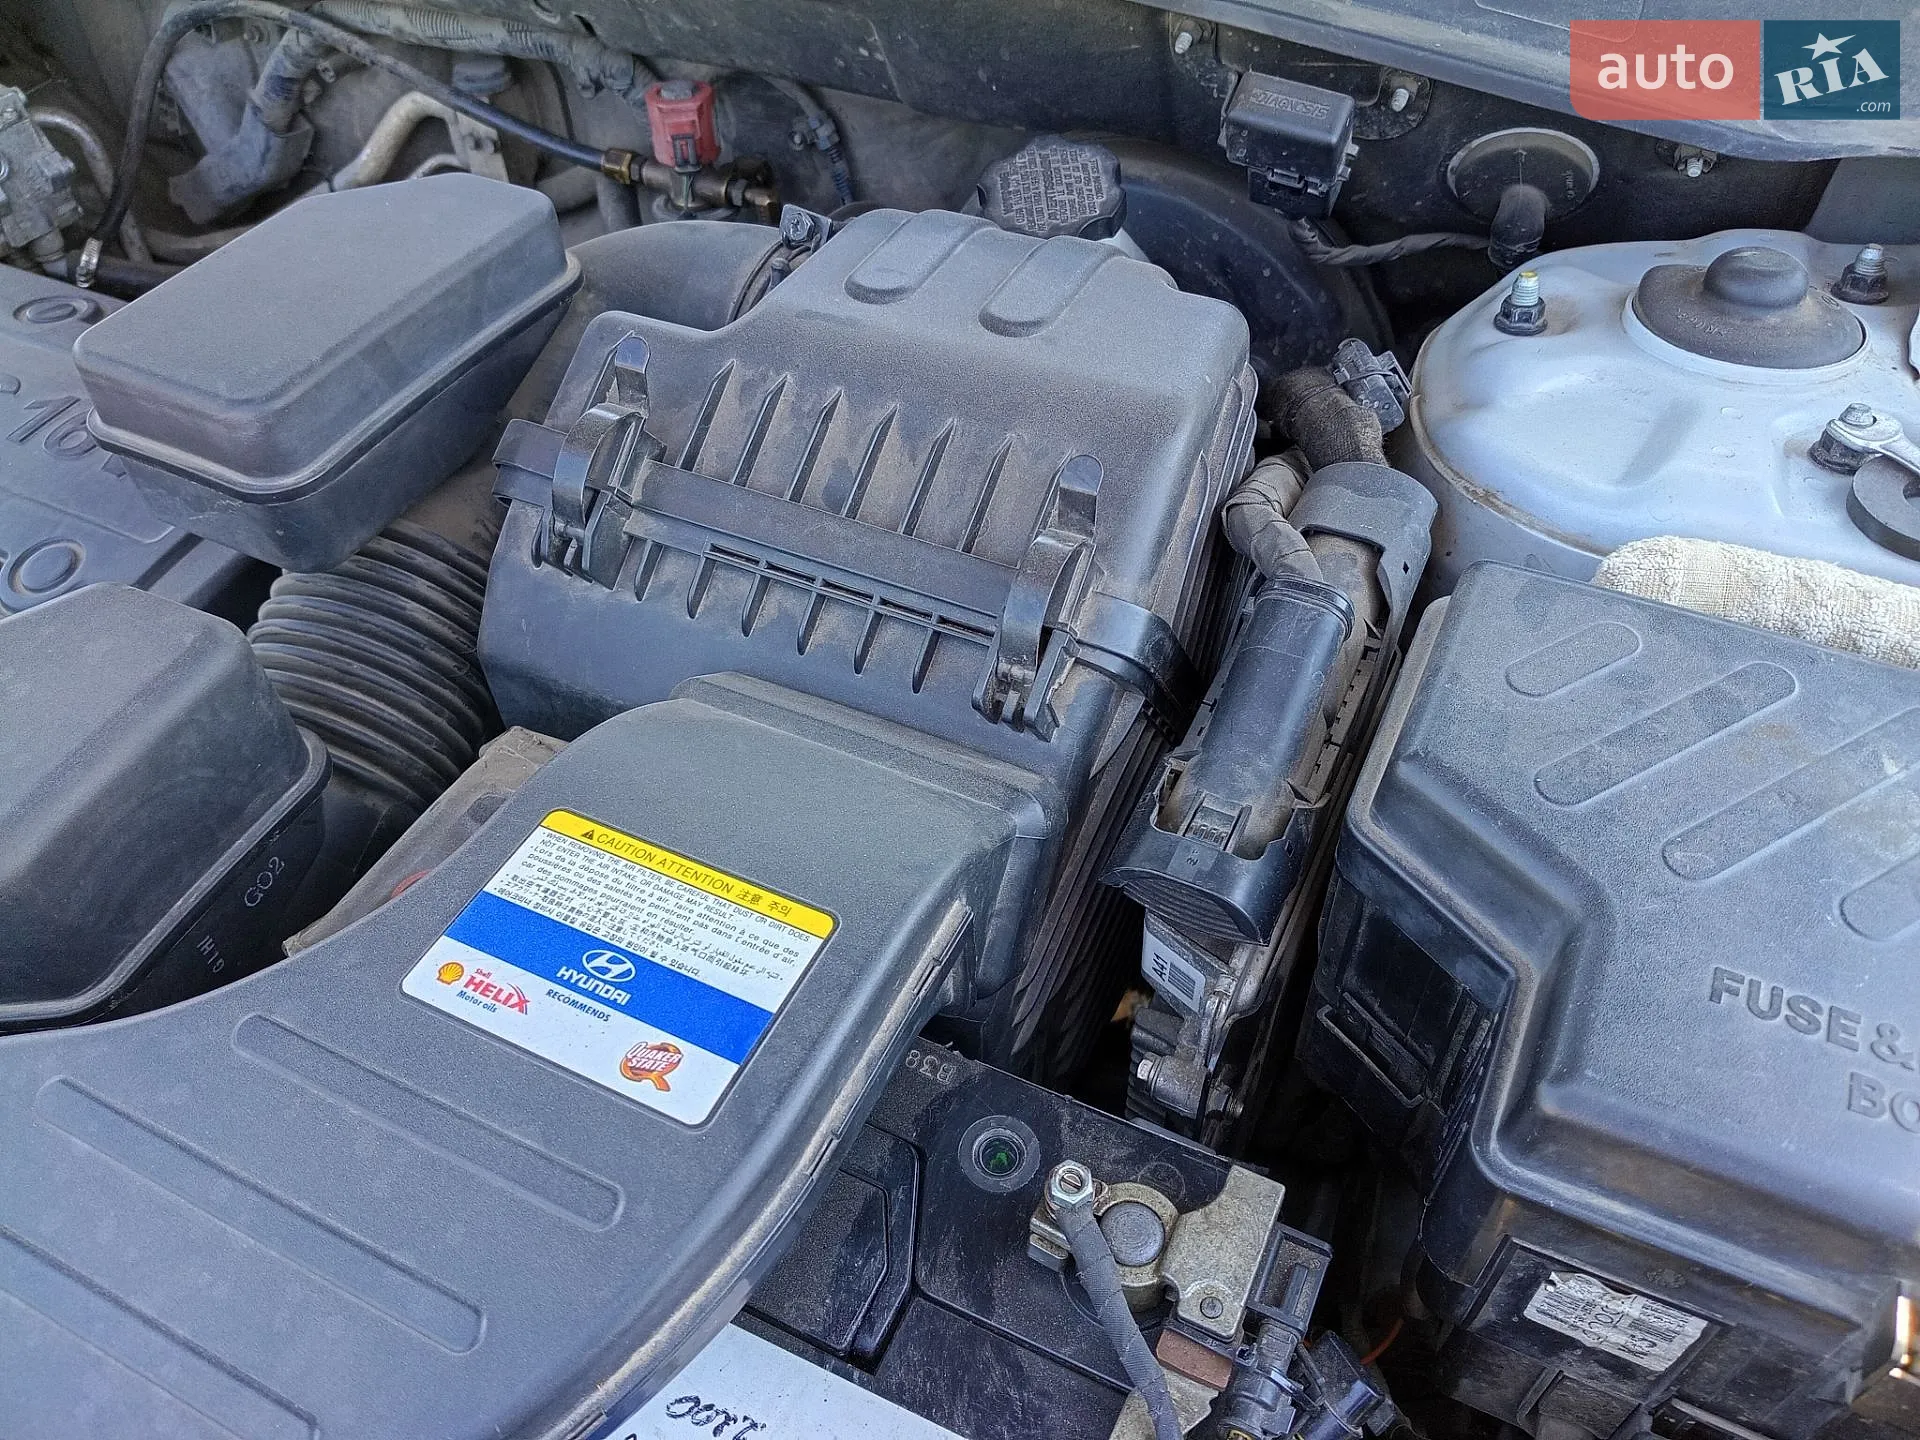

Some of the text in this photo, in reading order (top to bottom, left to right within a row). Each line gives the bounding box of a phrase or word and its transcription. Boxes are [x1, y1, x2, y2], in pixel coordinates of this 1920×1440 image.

[539, 838, 556, 848] NOT
[556, 844, 581, 858] ENTER
[580, 854, 597, 864] THE
[596, 860, 611, 870] AIR
[651, 883, 684, 900] DAMAGE
[684, 896, 703, 908] MAY
[545, 831, 568, 844] WHEN
[567, 840, 606, 859] REMOVING
[606, 855, 622, 865] THE
[621, 862, 636, 871] AIR
[663, 879, 676, 887] BE
[711, 898, 732, 910] THAT
[732, 906, 754, 919] DUST
[594, 832, 734, 894] CAUTION ATTENTION
[533, 845, 554, 857] Lors
[695, 911, 737, 932] attention
[761, 938, 781, 949] que
[552, 872, 599, 895] dommages
[765, 899, 793, 917] 주의
[710, 926, 734, 939] dans
[1151, 952, 1168, 982] A41
[455, 989, 500, 1013] Motor oils
[462, 975, 531, 1013] HELIX
[554, 965, 632, 1006] HYUNDAI
[544, 988, 612, 1023] RECOMMENDS
[1709, 966, 1915, 1072] FUSE &
[627, 1042, 684, 1064] QUAKER
[628, 1057, 669, 1073] STATE
